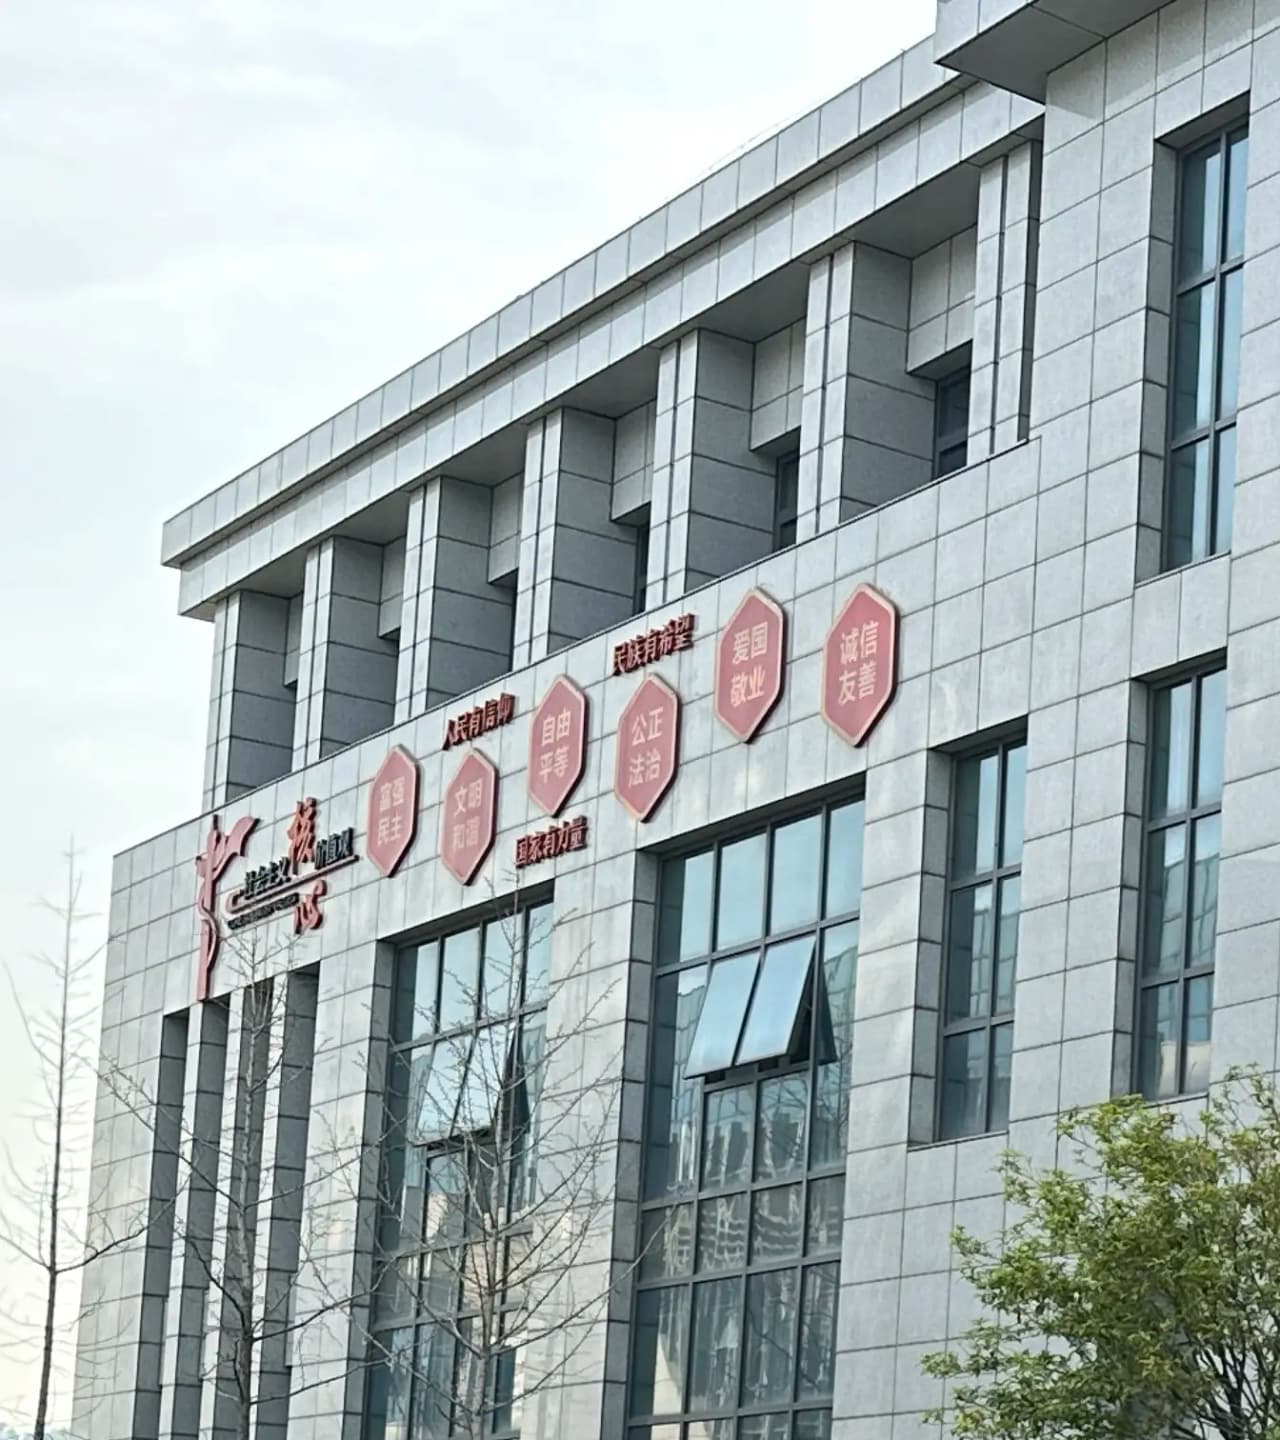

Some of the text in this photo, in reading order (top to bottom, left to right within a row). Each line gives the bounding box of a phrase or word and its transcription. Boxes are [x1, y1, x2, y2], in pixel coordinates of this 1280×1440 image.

[613, 614, 695, 676] 民族有希望
[732, 621, 769, 664] 爱国
[840, 620, 879, 664] 诚信
[730, 664, 766, 707] 敬业
[838, 661, 876, 707] 友善
[442, 692, 515, 750] 人民有信仰
[541, 709, 571, 747] 自由
[631, 706, 664, 746] 公正
[539, 746, 569, 784] 平等
[628, 749, 661, 787] 法治
[379, 776, 405, 812] 富强
[454, 777, 483, 816] 文明
[378, 816, 401, 847] 民主
[516, 815, 588, 868] 国家有力量
